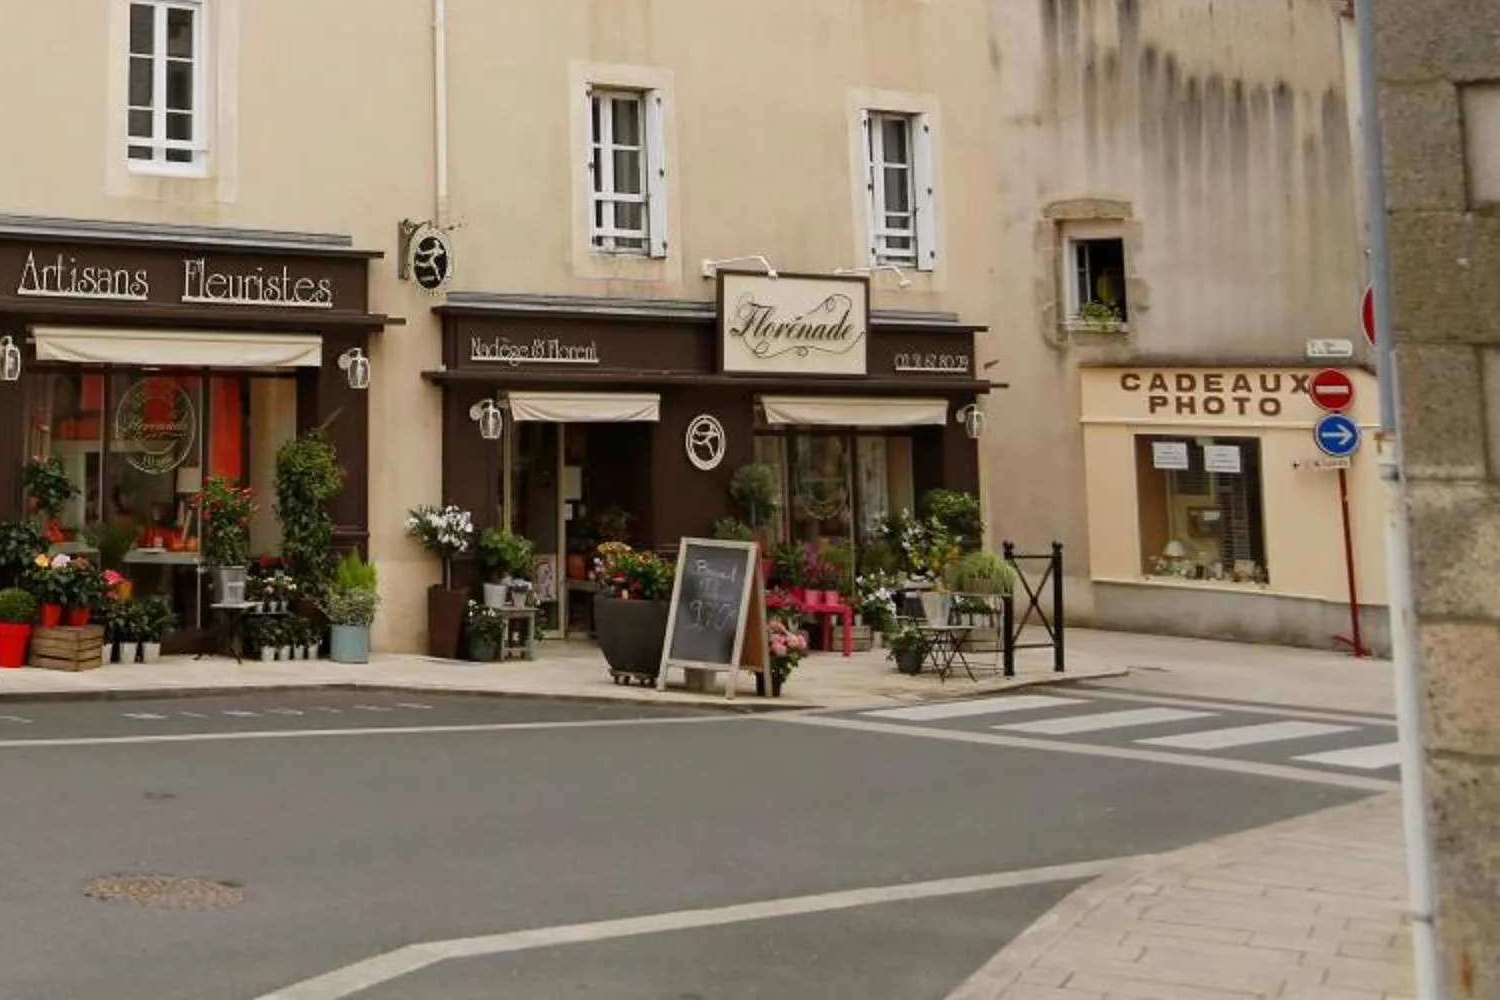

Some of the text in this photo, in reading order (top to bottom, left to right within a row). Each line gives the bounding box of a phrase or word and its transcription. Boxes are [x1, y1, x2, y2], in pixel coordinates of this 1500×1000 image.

[17, 249, 333, 308] Artisans Fleuristes
[728, 293, 857, 341] Florénade
[1120, 373, 1310, 394] CADEAUX
[1148, 395, 1282, 417] PHOTO
